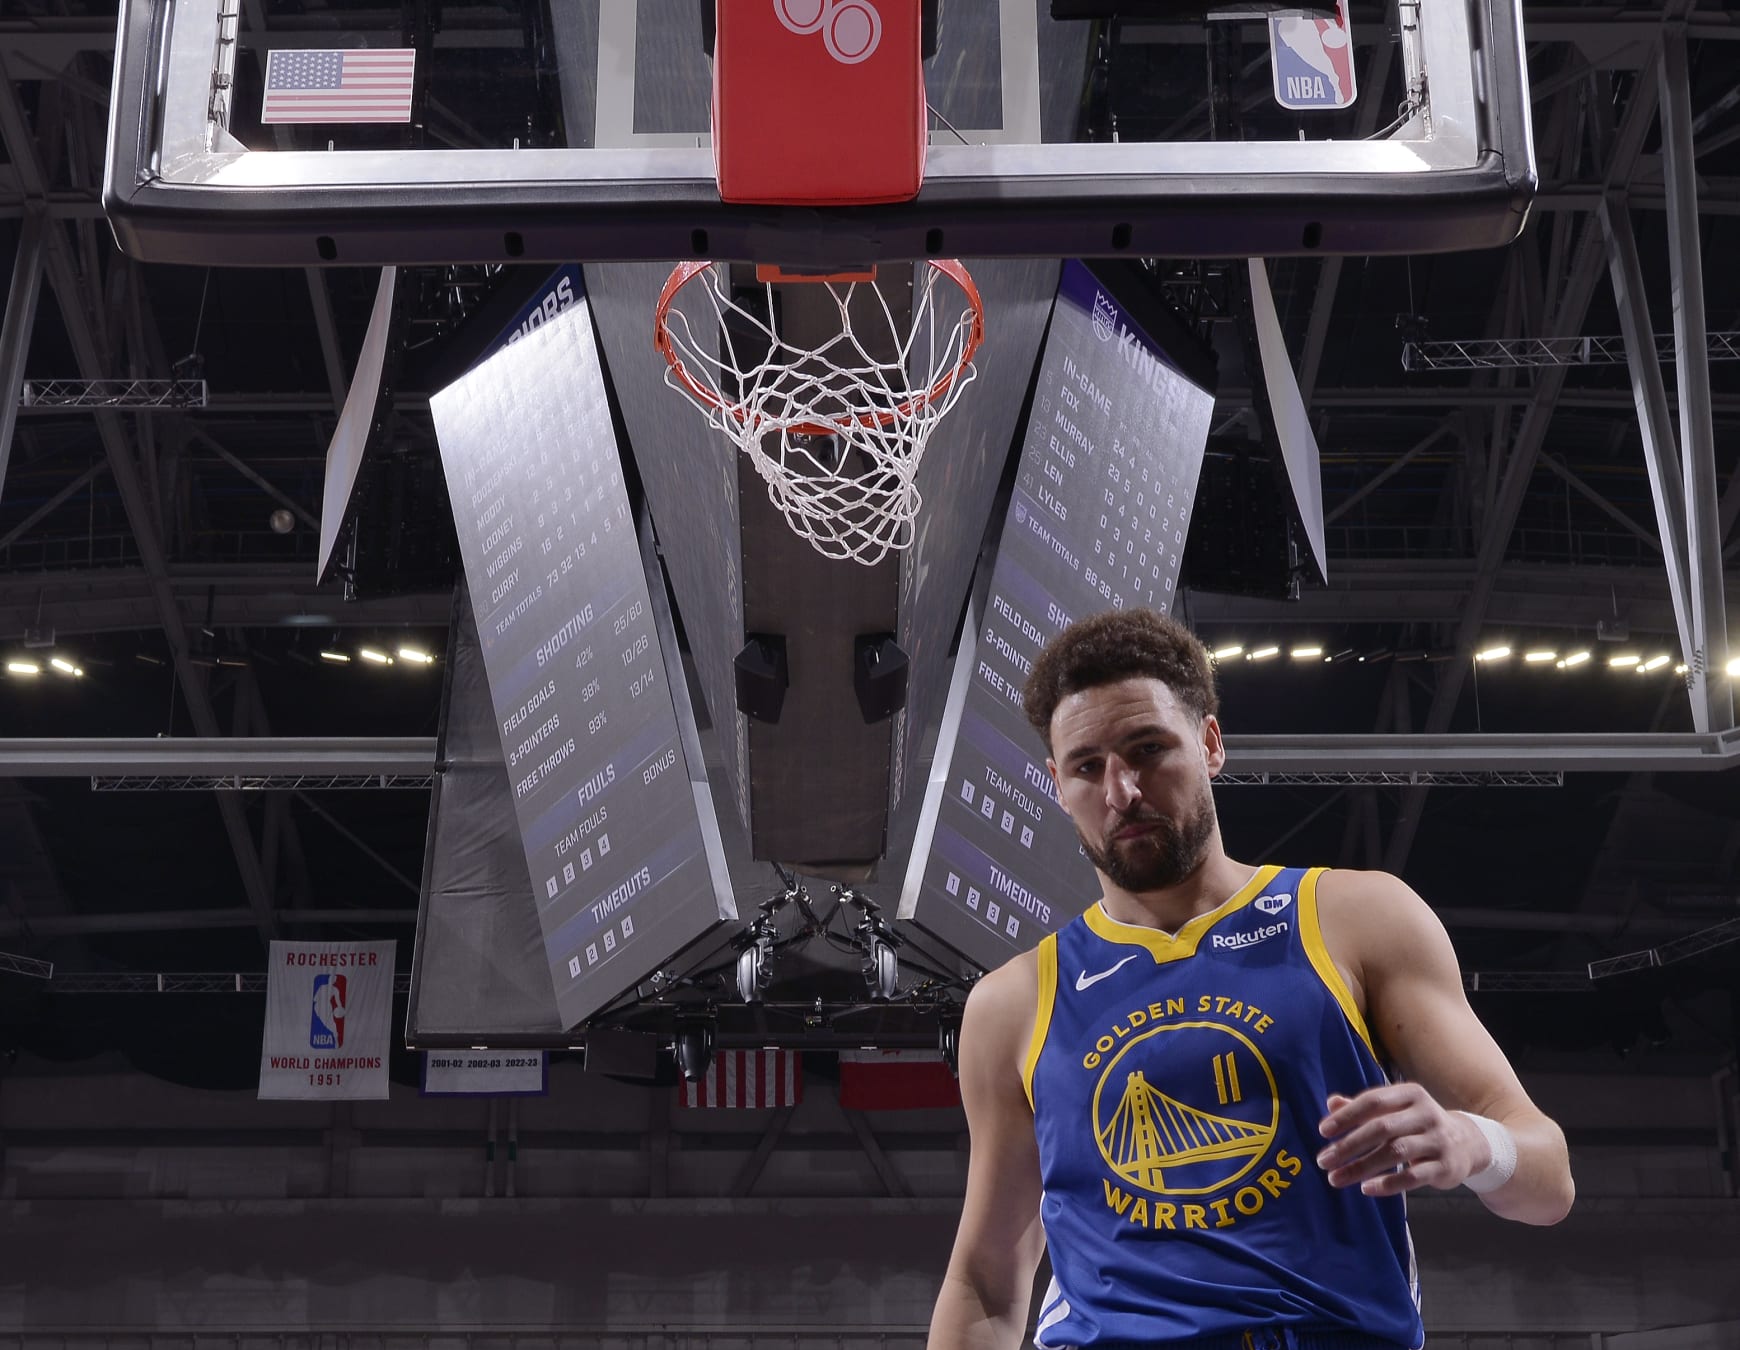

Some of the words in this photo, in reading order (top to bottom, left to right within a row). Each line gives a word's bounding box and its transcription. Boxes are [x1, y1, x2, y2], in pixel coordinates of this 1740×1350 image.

[1287, 76, 1326, 99] NBA
[1063, 356, 1112, 416] IN-GAME
[1117, 323, 1186, 406] KINGS
[1055, 410, 1094, 457] MURRAY
[1108, 463, 1120, 483] 23
[1124, 479, 1131, 493] 5
[1137, 492, 1144, 506] 0
[1149, 504, 1156, 519] 0
[1162, 517, 1169, 532] 2
[1175, 530, 1182, 544] 0
[1061, 386, 1080, 412] FOX
[1113, 439, 1125, 459] 24
[1129, 455, 1136, 469] 4
[1142, 468, 1149, 482] 5
[1154, 481, 1161, 495] 0
[1167, 494, 1174, 508] 2
[1179, 507, 1186, 521] 2
[1043, 460, 1063, 487] LEN
[1100, 514, 1108, 530] 0
[1113, 527, 1120, 542] 3
[1126, 540, 1134, 555] 0
[1139, 552, 1146, 567] 0
[1152, 565, 1159, 580] 0
[1165, 577, 1172, 592] 0
[1049, 435, 1075, 468] ELLIS
[1103, 488, 1114, 507] 13
[1118, 503, 1125, 518] 4
[1131, 516, 1138, 531] 3
[1144, 528, 1151, 543] 2
[1157, 541, 1164, 556] 3
[1170, 554, 1177, 568] 3
[481, 516, 515, 555] LOONEY
[486, 536, 523, 579] WIGGINS
[1029, 516, 1050, 544] TEAM
[1051, 538, 1079, 571] TOTALS
[1085, 567, 1098, 587] 86
[1099, 580, 1111, 599] 36
[1113, 593, 1123, 610] 21
[1038, 485, 1068, 521] LYLES
[1094, 540, 1102, 555] 5
[1108, 552, 1115, 567] 5
[1134, 577, 1141, 592] 0
[492, 567, 521, 604] CURRY
[542, 538, 552, 555] 16
[556, 526, 564, 541] 2
[495, 613, 516, 635] TEAM
[516, 586, 543, 619] TOTALS
[547, 569, 559, 588] 73
[561, 558, 573, 575] 32
[575, 543, 586, 560] 13
[591, 532, 597, 545] 4
[604, 518, 611, 532] 5
[536, 603, 594, 667] SHOOTING
[993, 595, 1021, 628] FIELD
[503, 705, 527, 736] FIELD
[527, 680, 556, 715] GOALS
[575, 646, 593, 669] 42%
[614, 601, 643, 635] 25/60
[979, 661, 1004, 692] FREE
[986, 628, 1032, 676] 3-POINTE
[510, 714, 560, 766] 3-POINTERS
[581, 678, 600, 702] 38%
[622, 635, 649, 667] 10/26
[517, 773, 539, 798] FREE
[538, 739, 576, 779] THROWS
[588, 711, 607, 734] 93%
[629, 670, 655, 699] 13/14
[578, 764, 616, 807] FOULS
[643, 750, 676, 785] BONUS
[985, 766, 1012, 797] TEAM
[1012, 791, 1043, 822] FOULS
[554, 830, 579, 857] TEAM
[579, 806, 608, 840] FOULS
[591, 866, 651, 924] TIMEOUTS
[990, 865, 1051, 924] TIMEOUTS
[1263, 899, 1284, 910] DM
[286, 952, 378, 967] ROCHESTER
[1212, 922, 1288, 949] Rakuten
[313, 1034, 333, 1046] NBA
[1083, 997, 1185, 1071] GOLDEN
[1197, 995, 1275, 1034] STATE
[270, 1057, 310, 1069] WORLD
[314, 1056, 381, 1069] CHAMPIONS
[309, 1074, 341, 1086] 1951
[431, 1058, 463, 1068] 2001-02
[467, 1059, 501, 1069] 2002-03
[505, 1057, 538, 1068] 2022-23
[1212, 1051, 1242, 1105] 11
[1102, 1150, 1302, 1230] WARRIORS
